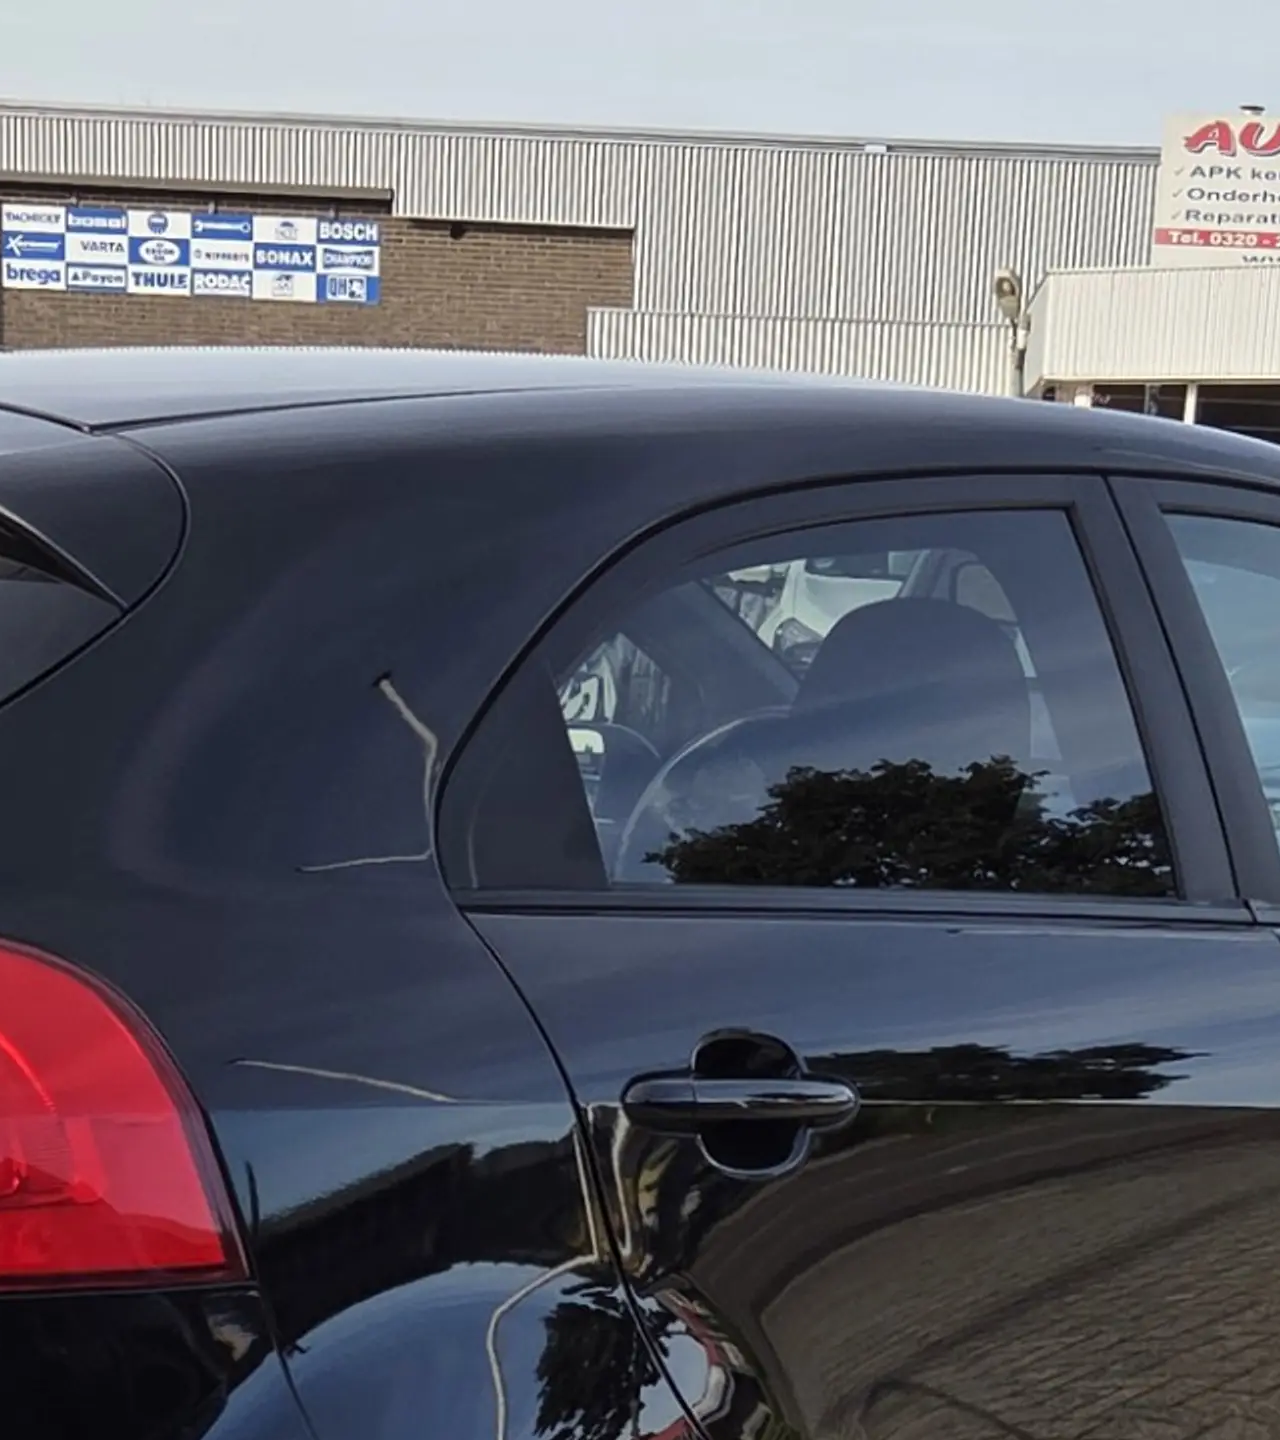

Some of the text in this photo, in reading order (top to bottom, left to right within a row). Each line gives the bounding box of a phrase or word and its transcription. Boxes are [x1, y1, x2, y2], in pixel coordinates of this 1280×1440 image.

[1190, 166, 1242, 179] APK
[320, 222, 377, 241] BOSCH
[1169, 231, 1203, 245] Tel.
[1210, 233, 1257, 246] 0320
[80, 240, 125, 253] VARTA
[7, 263, 61, 285] brega
[131, 272, 188, 289] THULE
